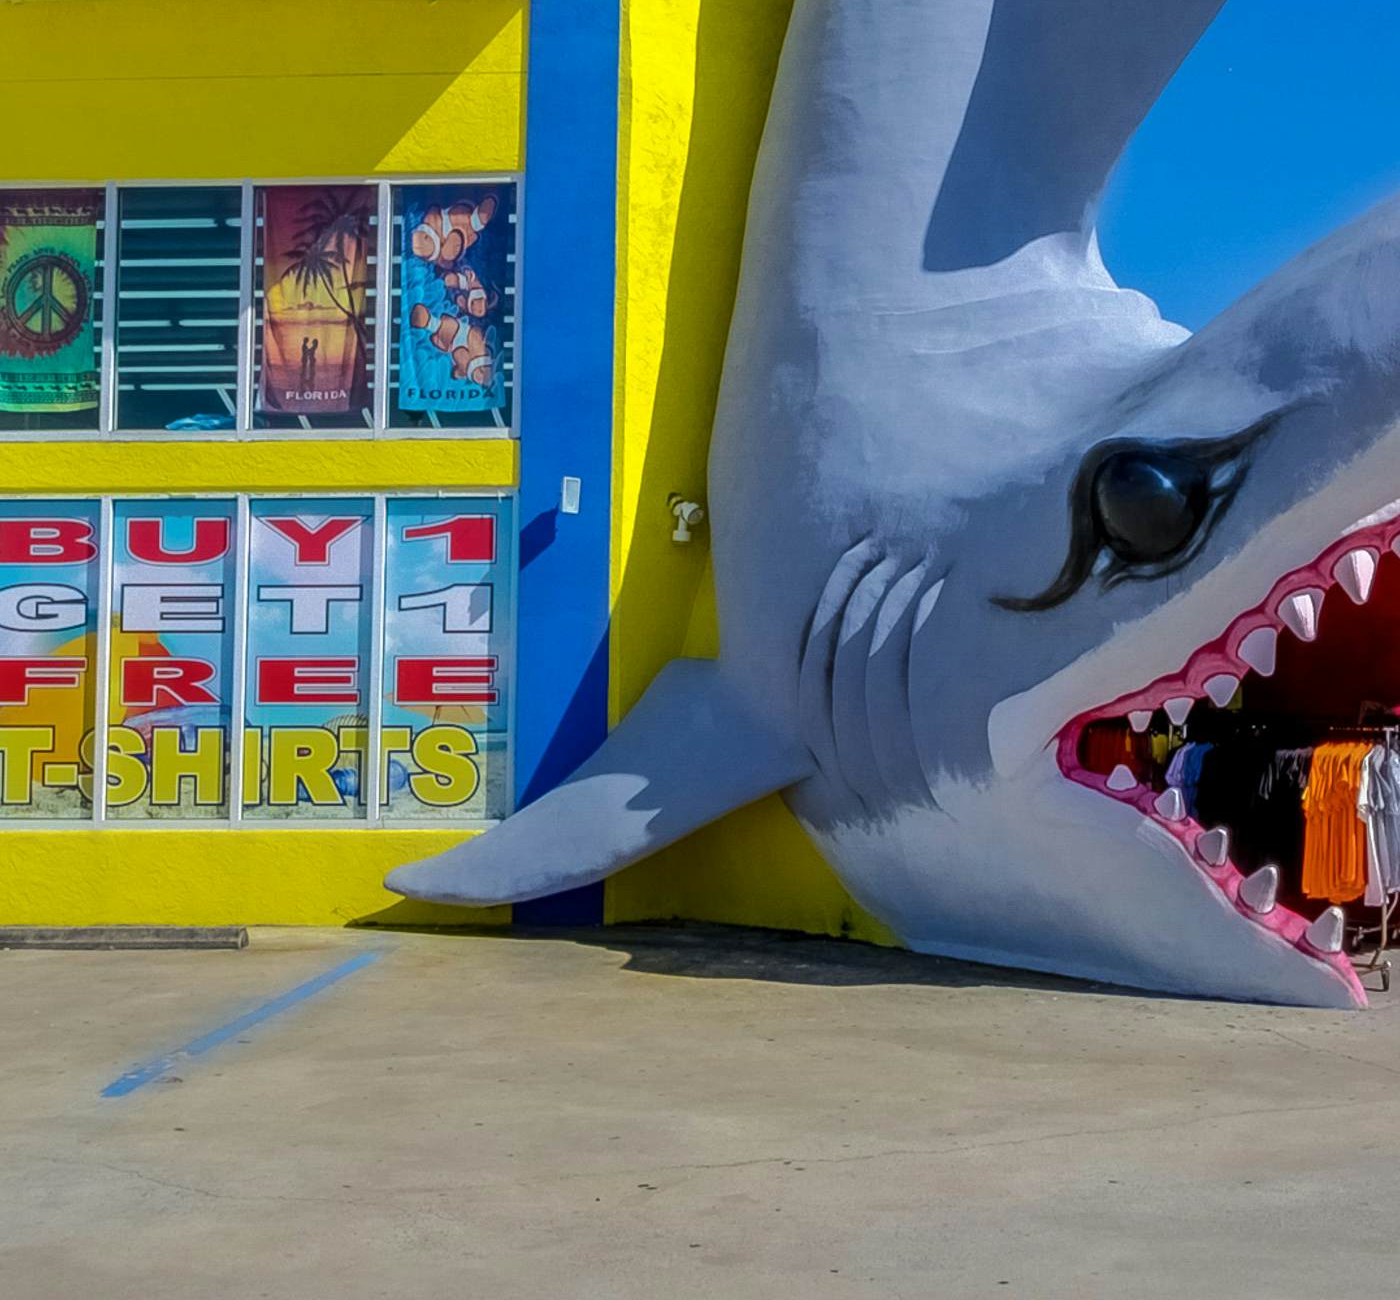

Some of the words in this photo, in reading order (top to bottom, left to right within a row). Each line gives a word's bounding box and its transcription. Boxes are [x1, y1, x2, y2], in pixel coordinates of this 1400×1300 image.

[285, 390, 347, 401] FLORIDA
[407, 387, 495, 400] FLORIDA
[0, 515, 371, 566] BUY
[402, 514, 498, 565] 1
[0, 582, 363, 635] GET
[398, 582, 494, 634] 1
[0, 655, 500, 707] FREE
[0, 723, 481, 807] T-SHIRTS
